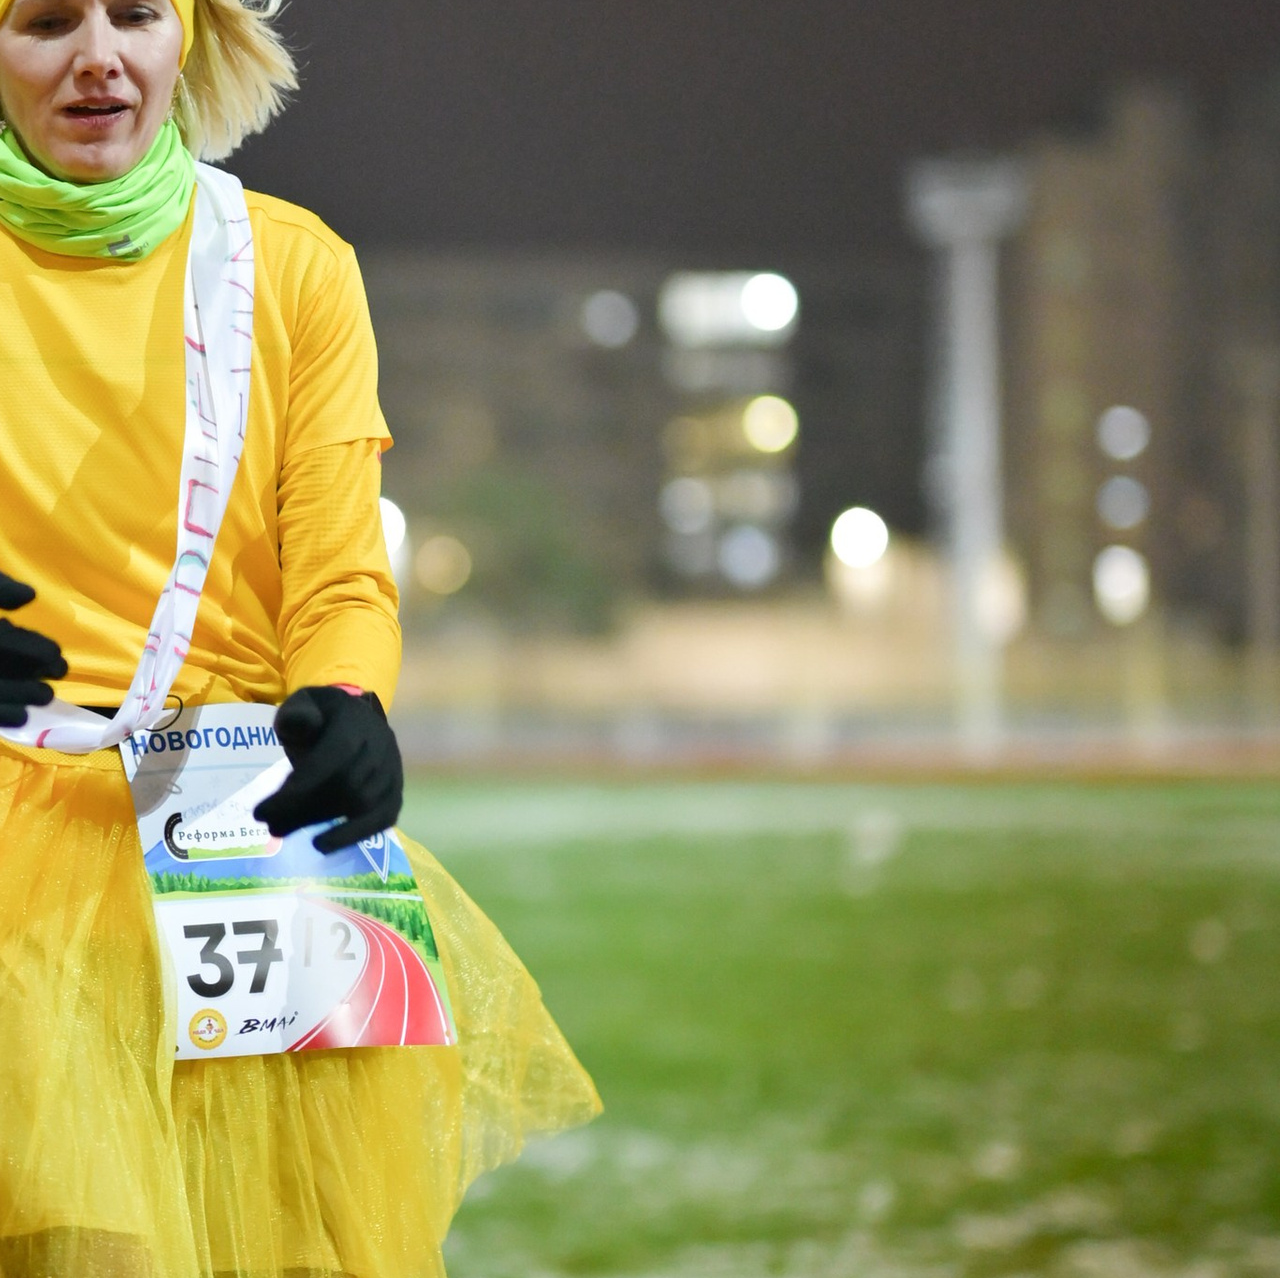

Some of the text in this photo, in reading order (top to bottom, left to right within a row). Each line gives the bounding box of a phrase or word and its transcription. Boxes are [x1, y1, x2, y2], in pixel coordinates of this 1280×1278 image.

[130, 725, 284, 756] НОВОГОДНИ
[178, 827, 269, 843] Реформа Бега
